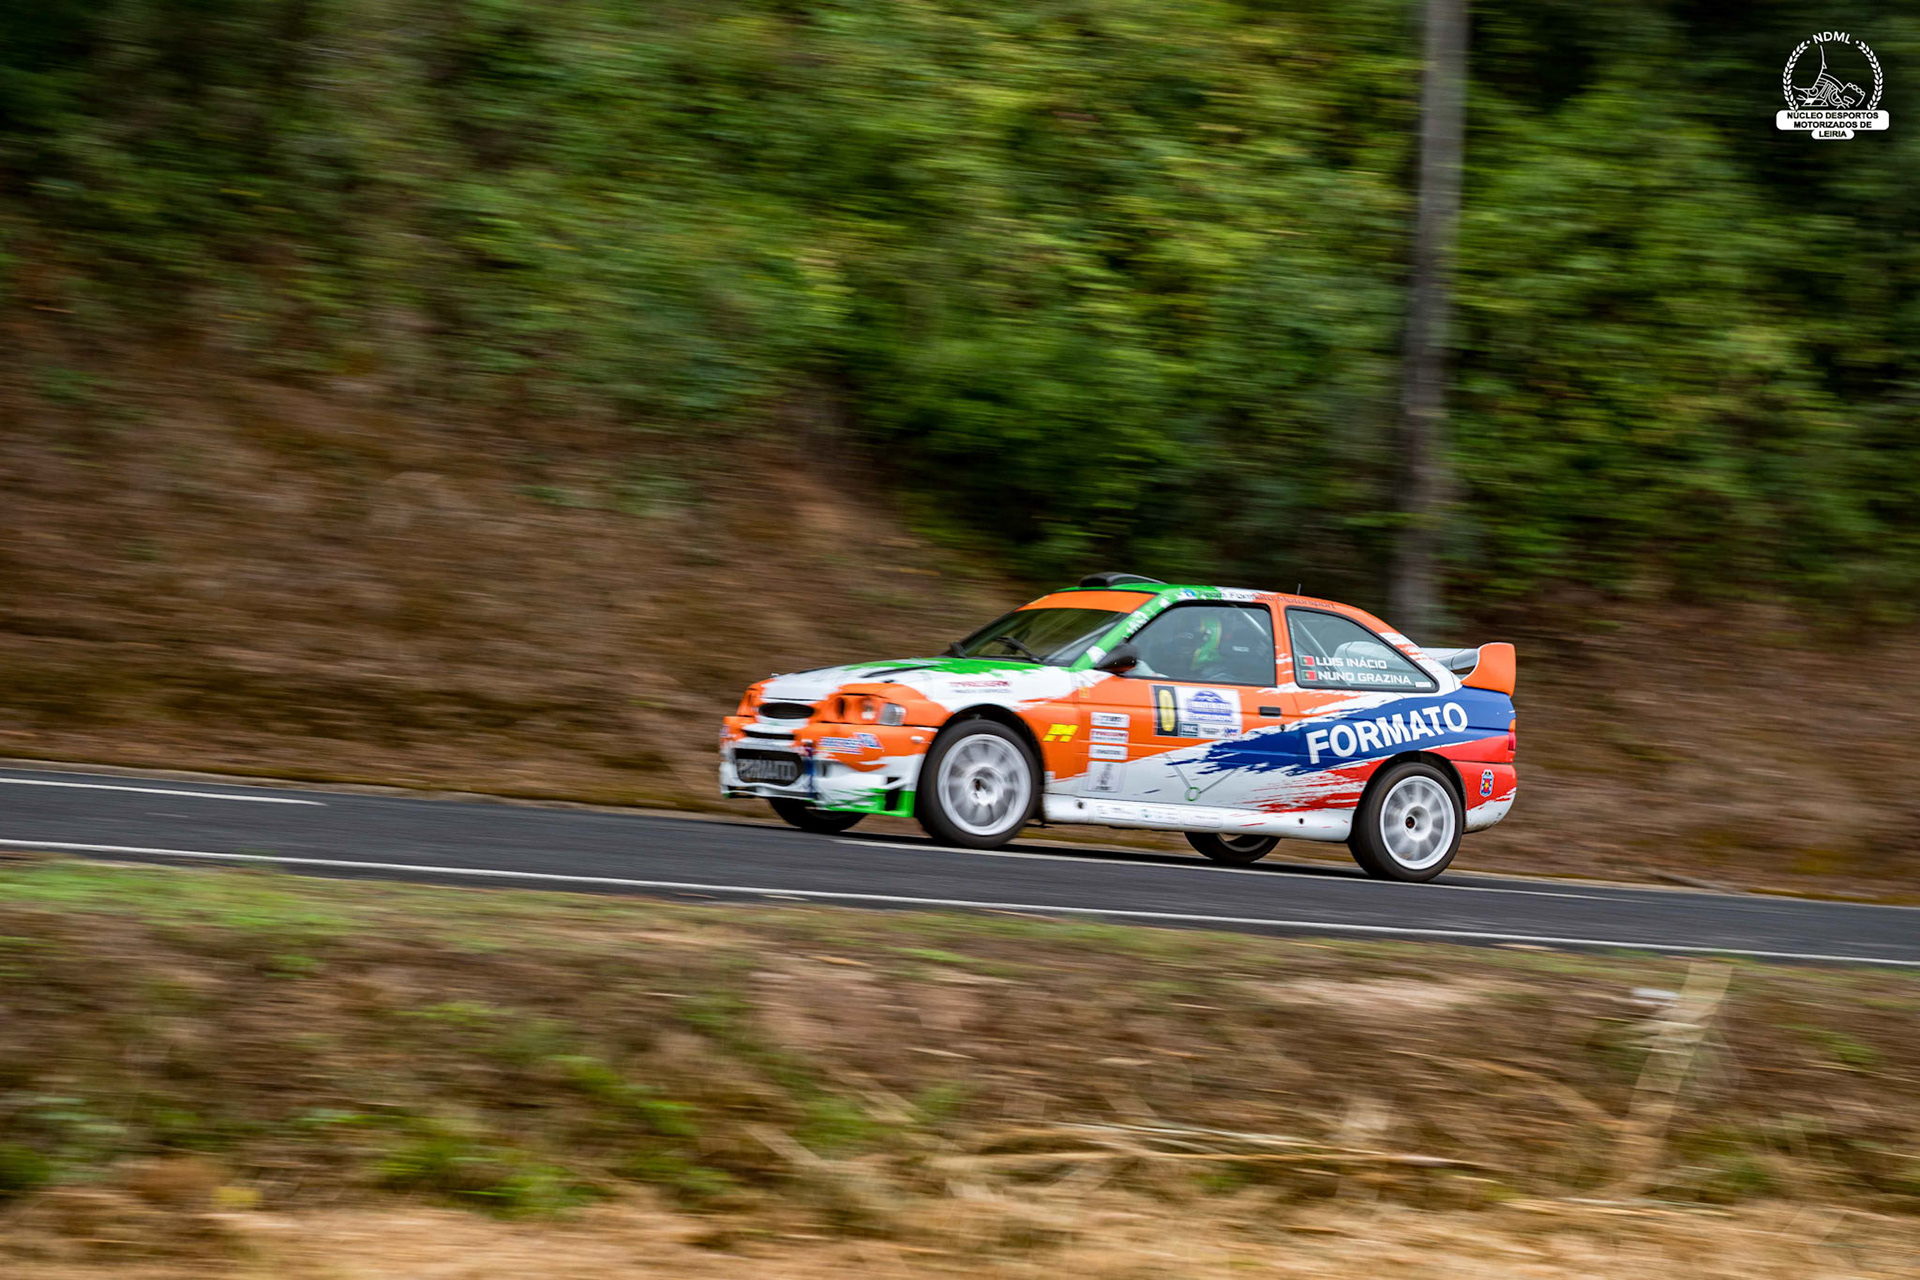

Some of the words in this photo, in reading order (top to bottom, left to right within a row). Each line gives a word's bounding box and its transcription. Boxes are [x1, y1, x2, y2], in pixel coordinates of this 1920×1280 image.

[1228, 591, 1276, 601] Formato
[1278, 594, 1336, 609] Motorsport
[1346, 655, 1388, 670] INÁCIO
[1357, 672, 1412, 685] GRAZINA
[1306, 702, 1469, 765] FORMATO
